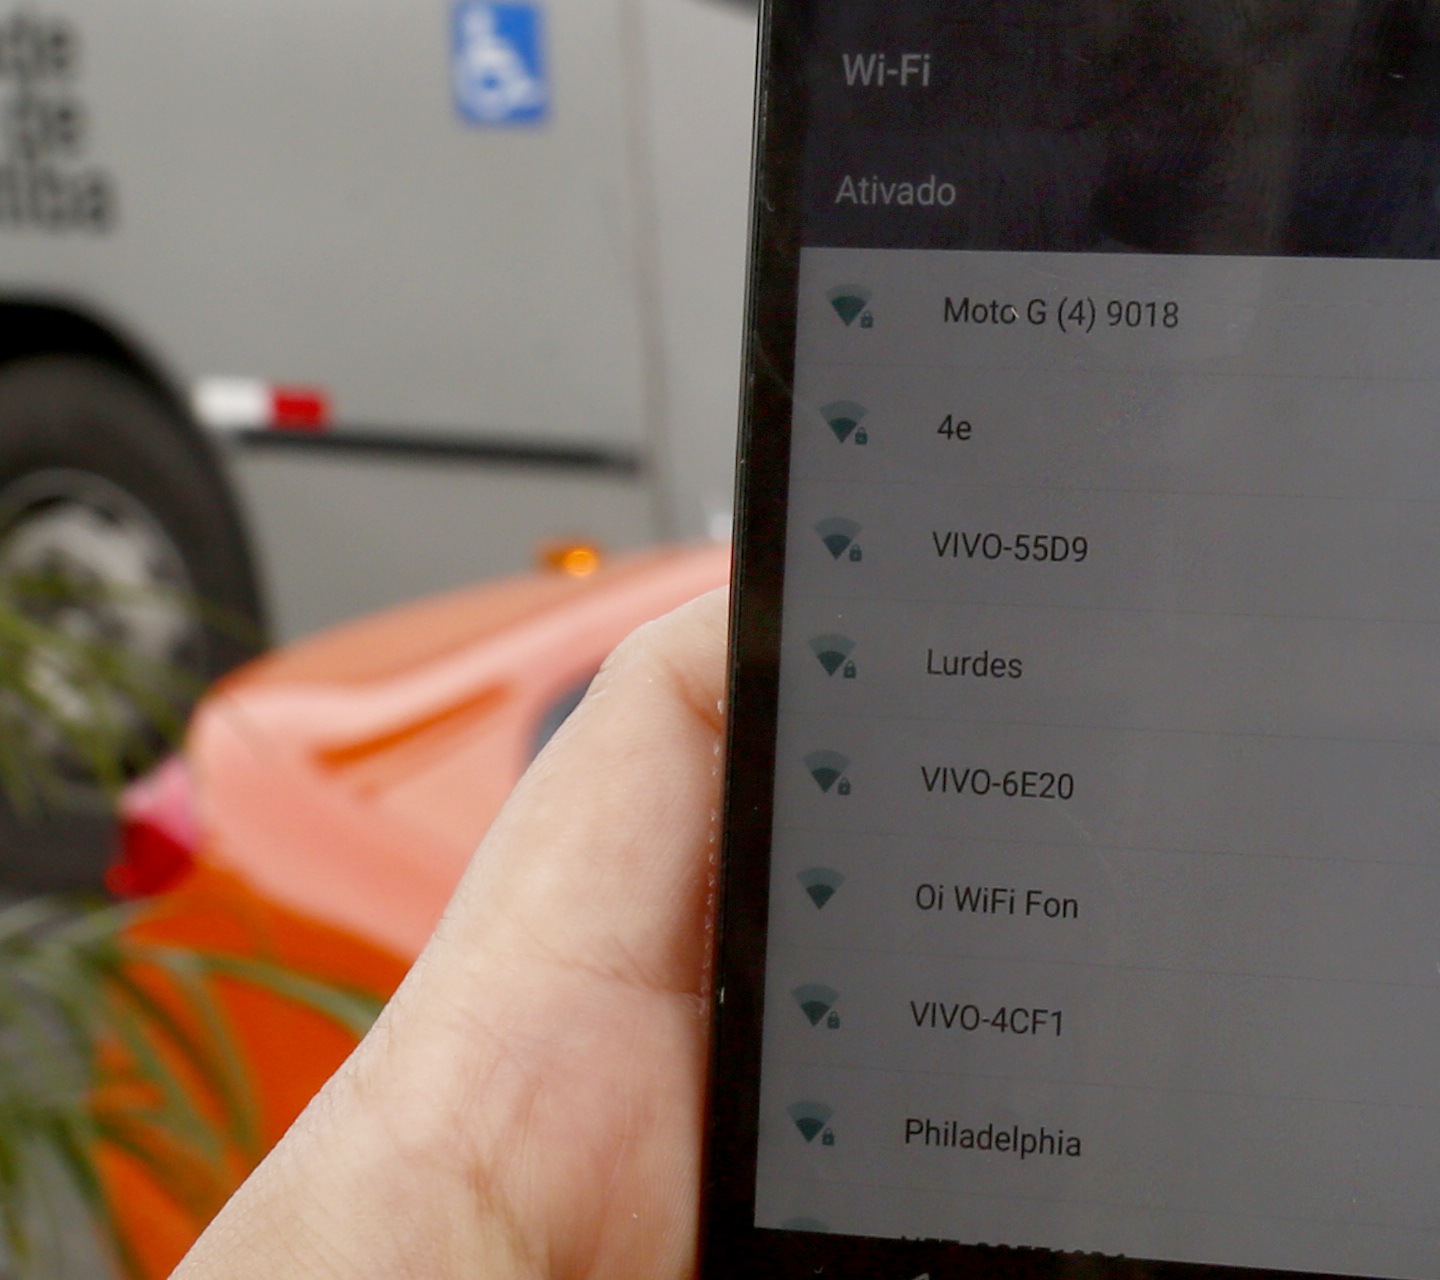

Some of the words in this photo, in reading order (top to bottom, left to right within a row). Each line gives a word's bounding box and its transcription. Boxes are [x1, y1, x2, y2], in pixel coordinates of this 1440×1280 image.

[841, 53, 931, 87] Wi-Fi
[2, 82, 86, 158] de
[834, 174, 957, 207] Ativado
[944, 296, 1017, 325] Moto
[1026, 298, 1047, 326] G
[1057, 297, 1096, 334] (4)
[1107, 300, 1179, 328] 9018
[936, 414, 972, 441] 4e
[932, 531, 1088, 563] VIVO-55D9
[927, 648, 1023, 679] Lurdes
[921, 766, 1074, 800] VIVO-6E20
[915, 883, 944, 911] Oi
[954, 885, 1015, 915] WiFi
[1025, 889, 1078, 919] Fon
[910, 1000, 1063, 1037] VIVO-4CF1
[905, 1118, 1081, 1160] Philadelphia
